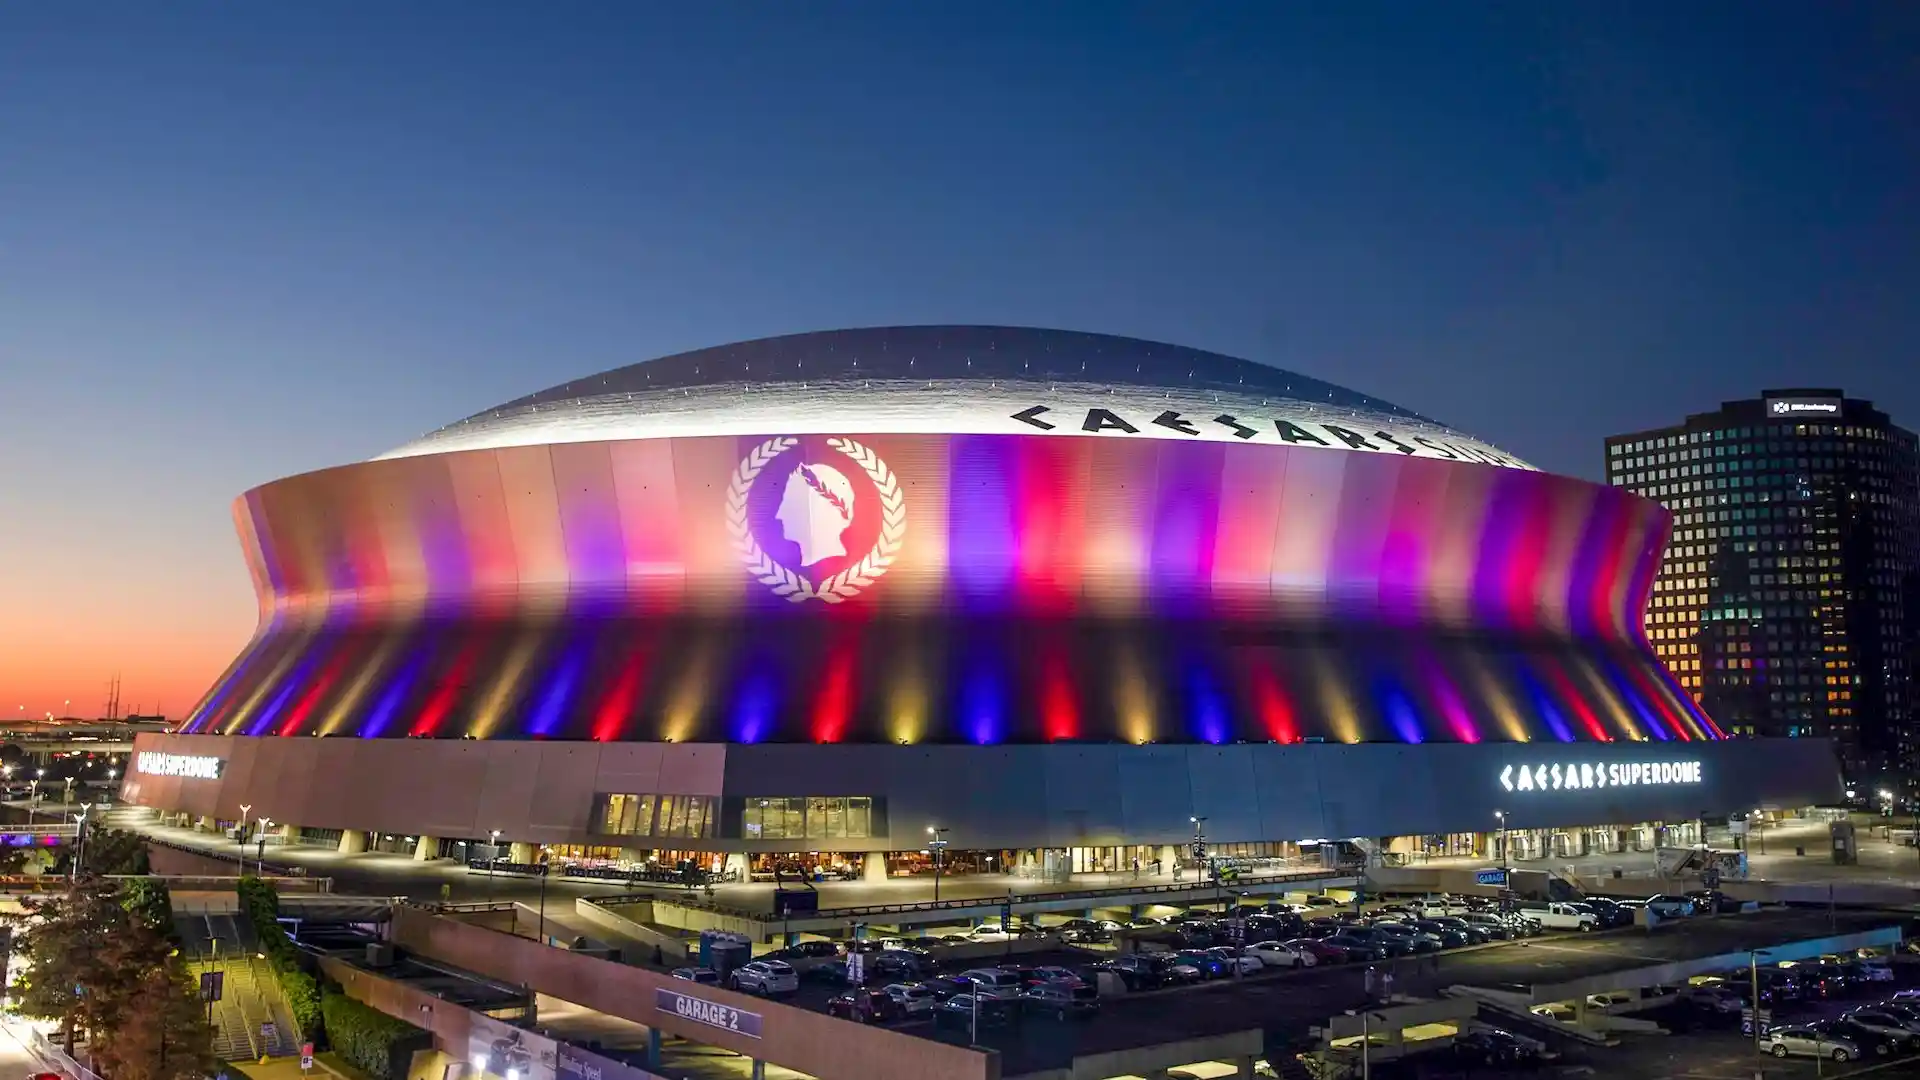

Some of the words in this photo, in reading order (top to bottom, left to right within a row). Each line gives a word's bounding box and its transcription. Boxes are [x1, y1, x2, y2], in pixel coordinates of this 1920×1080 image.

[1009, 404, 1416, 456] CAESARS
[165, 754, 219, 780] SUPERDOME
[1500, 762, 1607, 792] CAESARS
[1609, 761, 1702, 786] SUPERDOME
[676, 996, 727, 1026] GARAGE
[730, 1011, 738, 1030] 2
[1743, 1021, 1752, 1033] 2
[1761, 1023, 1768, 1034] 2
